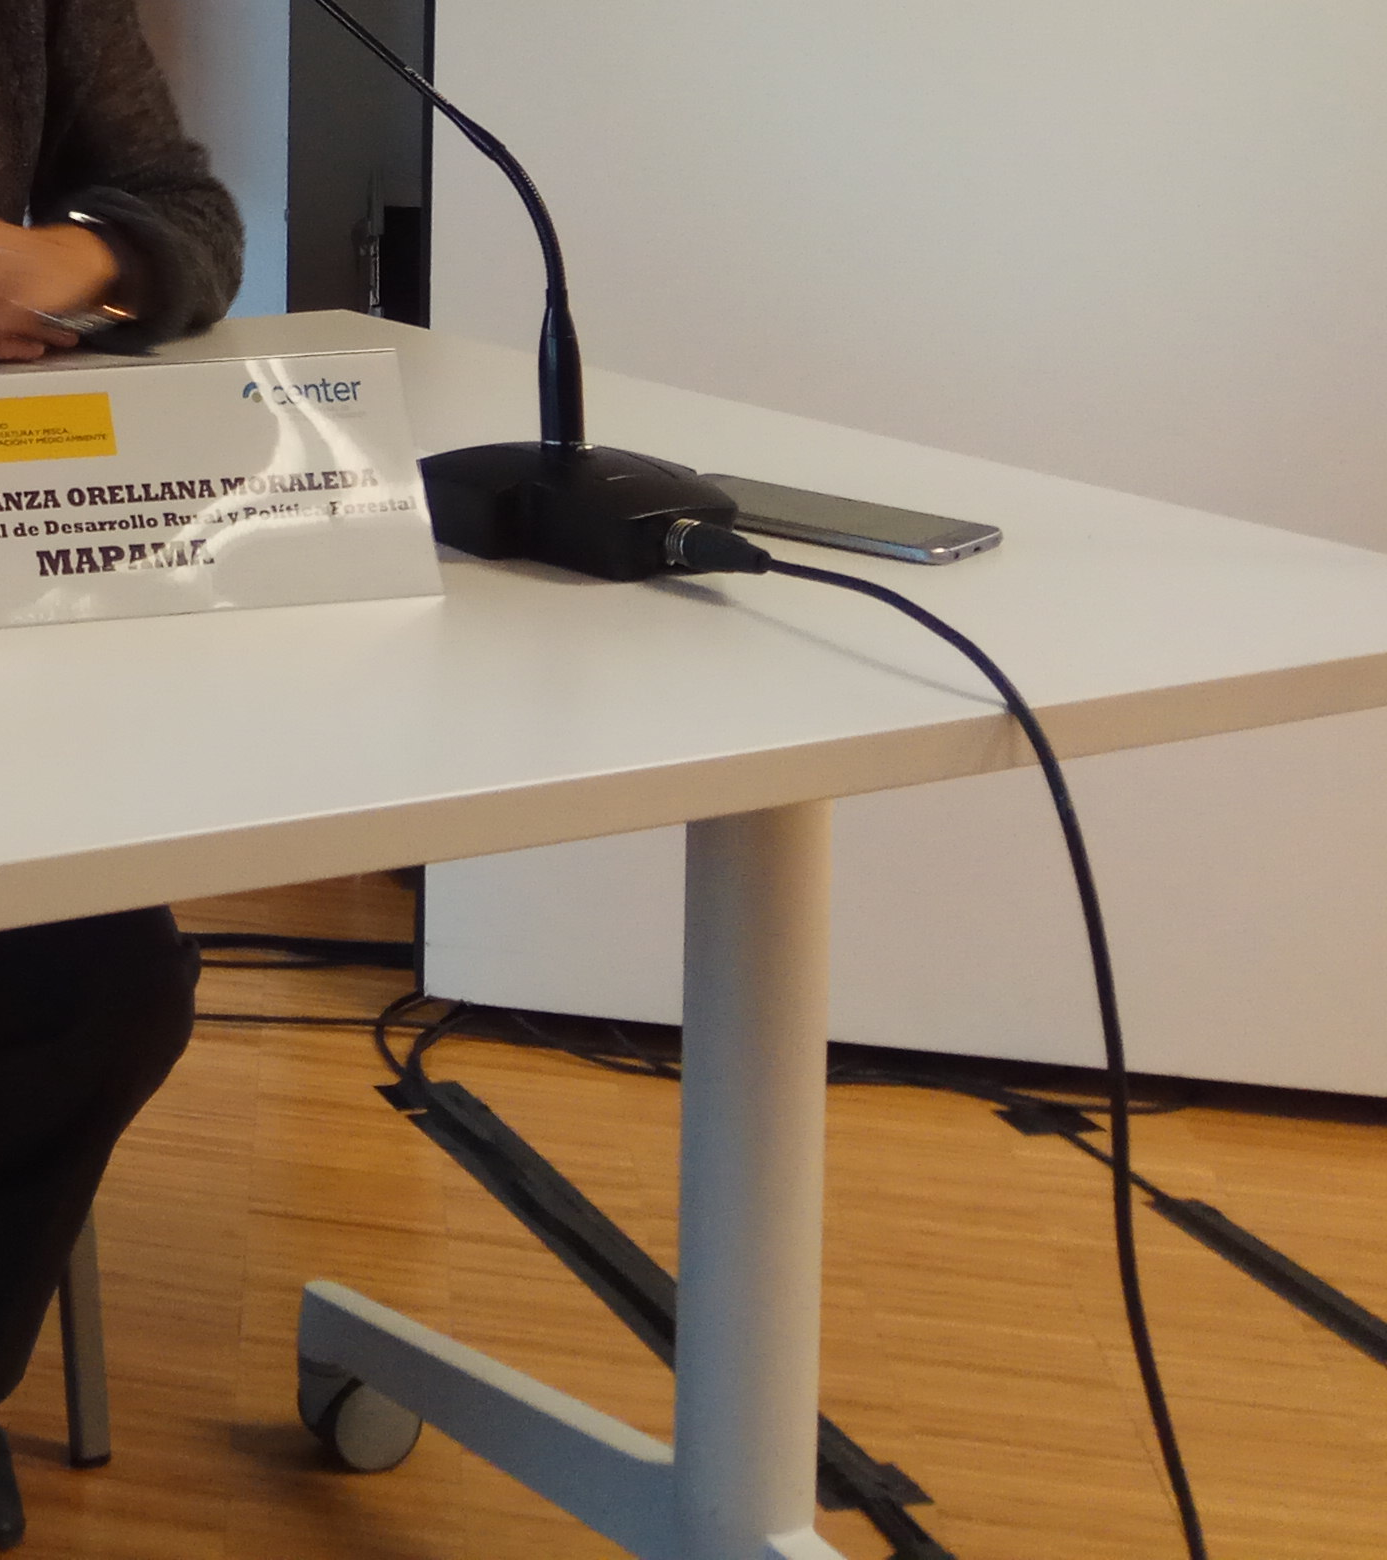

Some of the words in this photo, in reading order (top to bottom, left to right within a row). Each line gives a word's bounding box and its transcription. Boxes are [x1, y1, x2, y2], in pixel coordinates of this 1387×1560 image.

[67, 478, 216, 507] ORELLANA
[13, 522, 40, 538] de
[44, 513, 158, 536] Desarrollo
[227, 511, 239, 525] y
